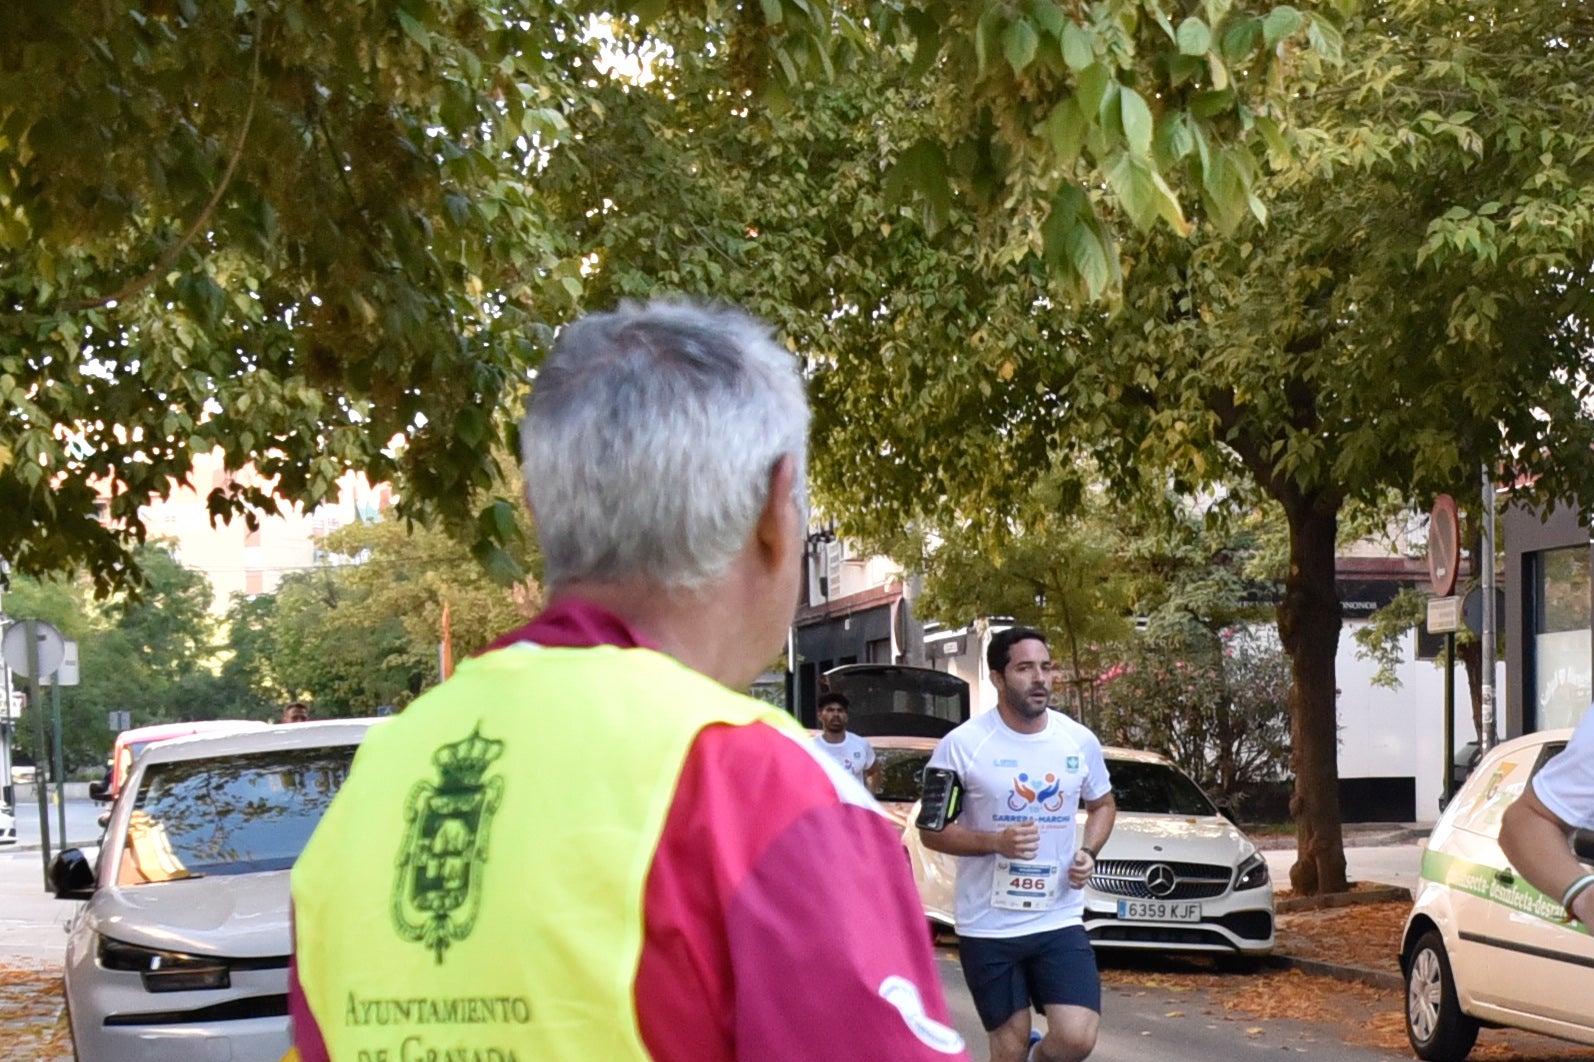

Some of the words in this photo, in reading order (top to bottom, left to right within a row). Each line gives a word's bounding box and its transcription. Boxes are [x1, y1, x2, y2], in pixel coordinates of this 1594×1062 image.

[1009, 878, 1045, 890] 486
[1128, 903, 1166, 918] 6359
[1170, 904, 1197, 919] KJF
[345, 992, 531, 1026] AYUNTAMIENTO
